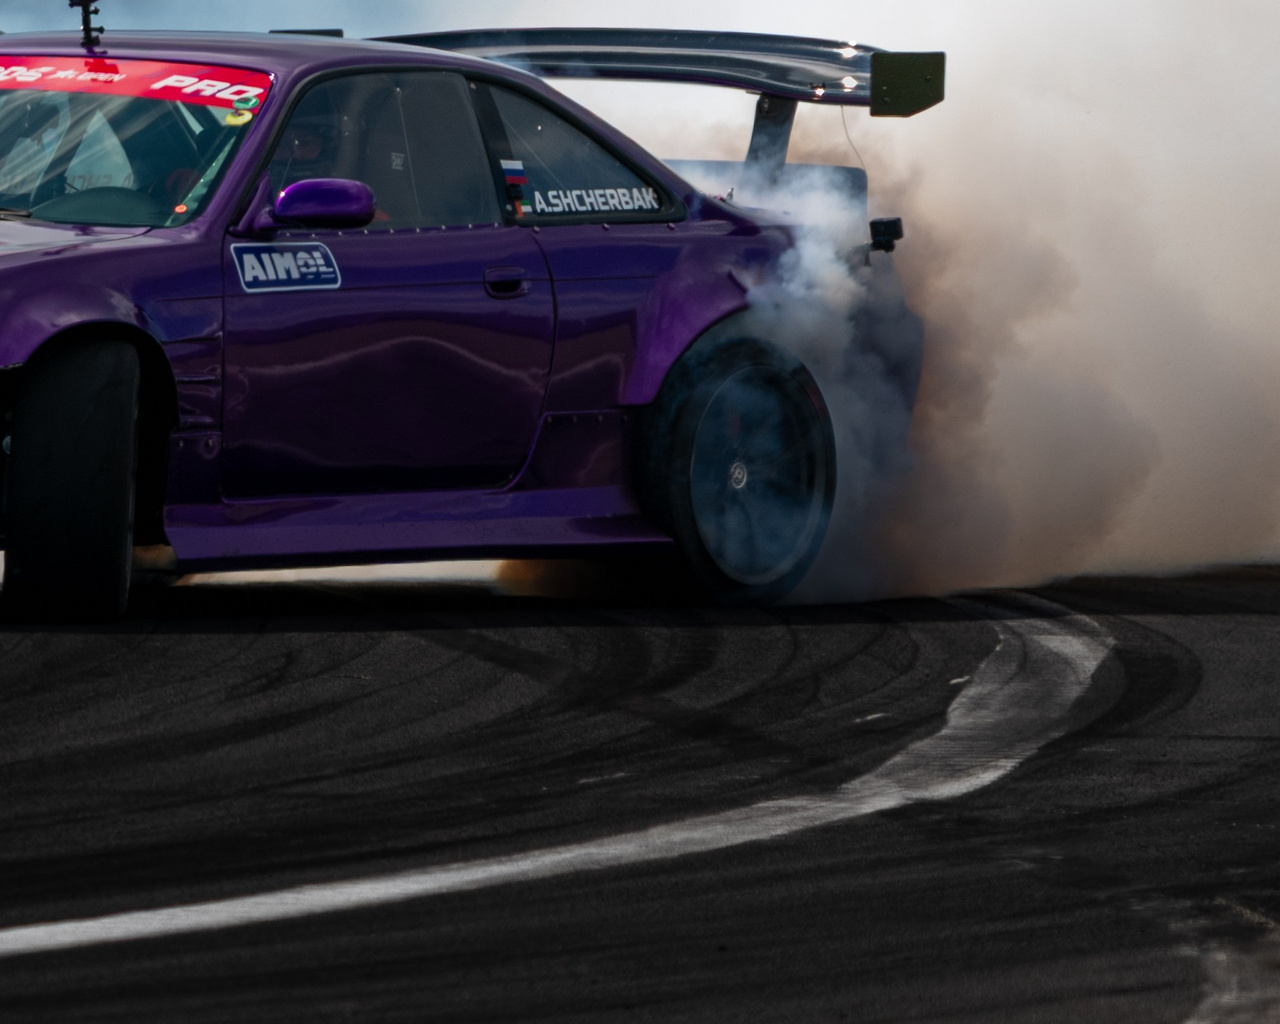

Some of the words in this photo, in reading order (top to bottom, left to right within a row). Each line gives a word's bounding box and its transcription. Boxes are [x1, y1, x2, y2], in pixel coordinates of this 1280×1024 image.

[150, 74, 265, 100] PRO
[534, 187, 660, 213] A.SHCHERBAK
[243, 250, 335, 282] AIMOL
